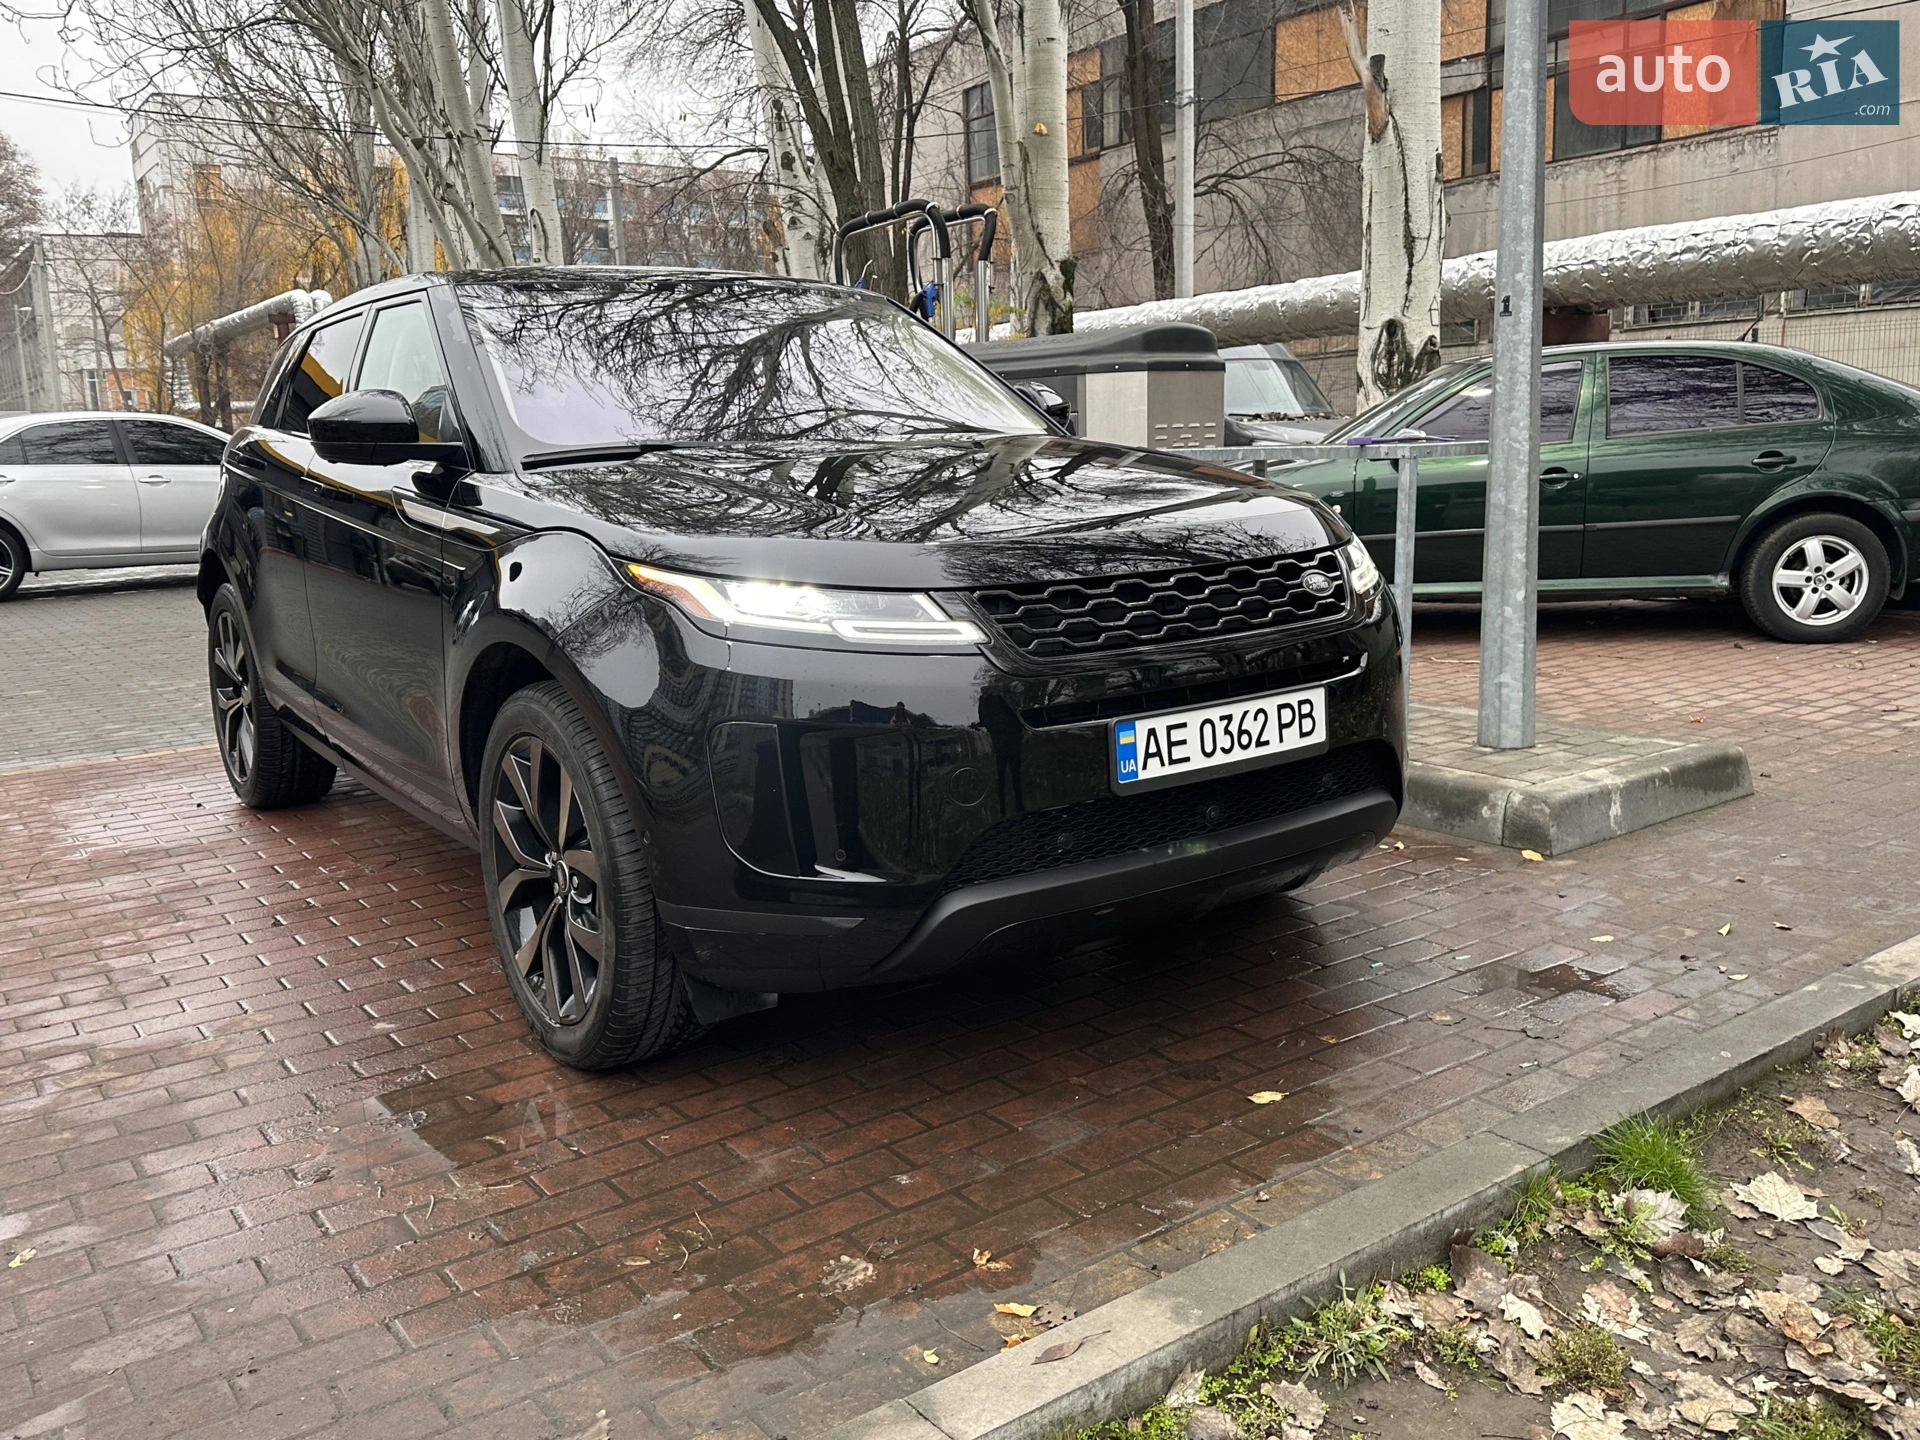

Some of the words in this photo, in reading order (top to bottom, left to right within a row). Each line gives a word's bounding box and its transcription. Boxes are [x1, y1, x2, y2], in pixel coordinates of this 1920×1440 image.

[1141, 721, 1191, 771] AE
[1199, 707, 1270, 759] 0362
[1276, 698, 1317, 744] PB
[1120, 759, 1137, 773] UA
